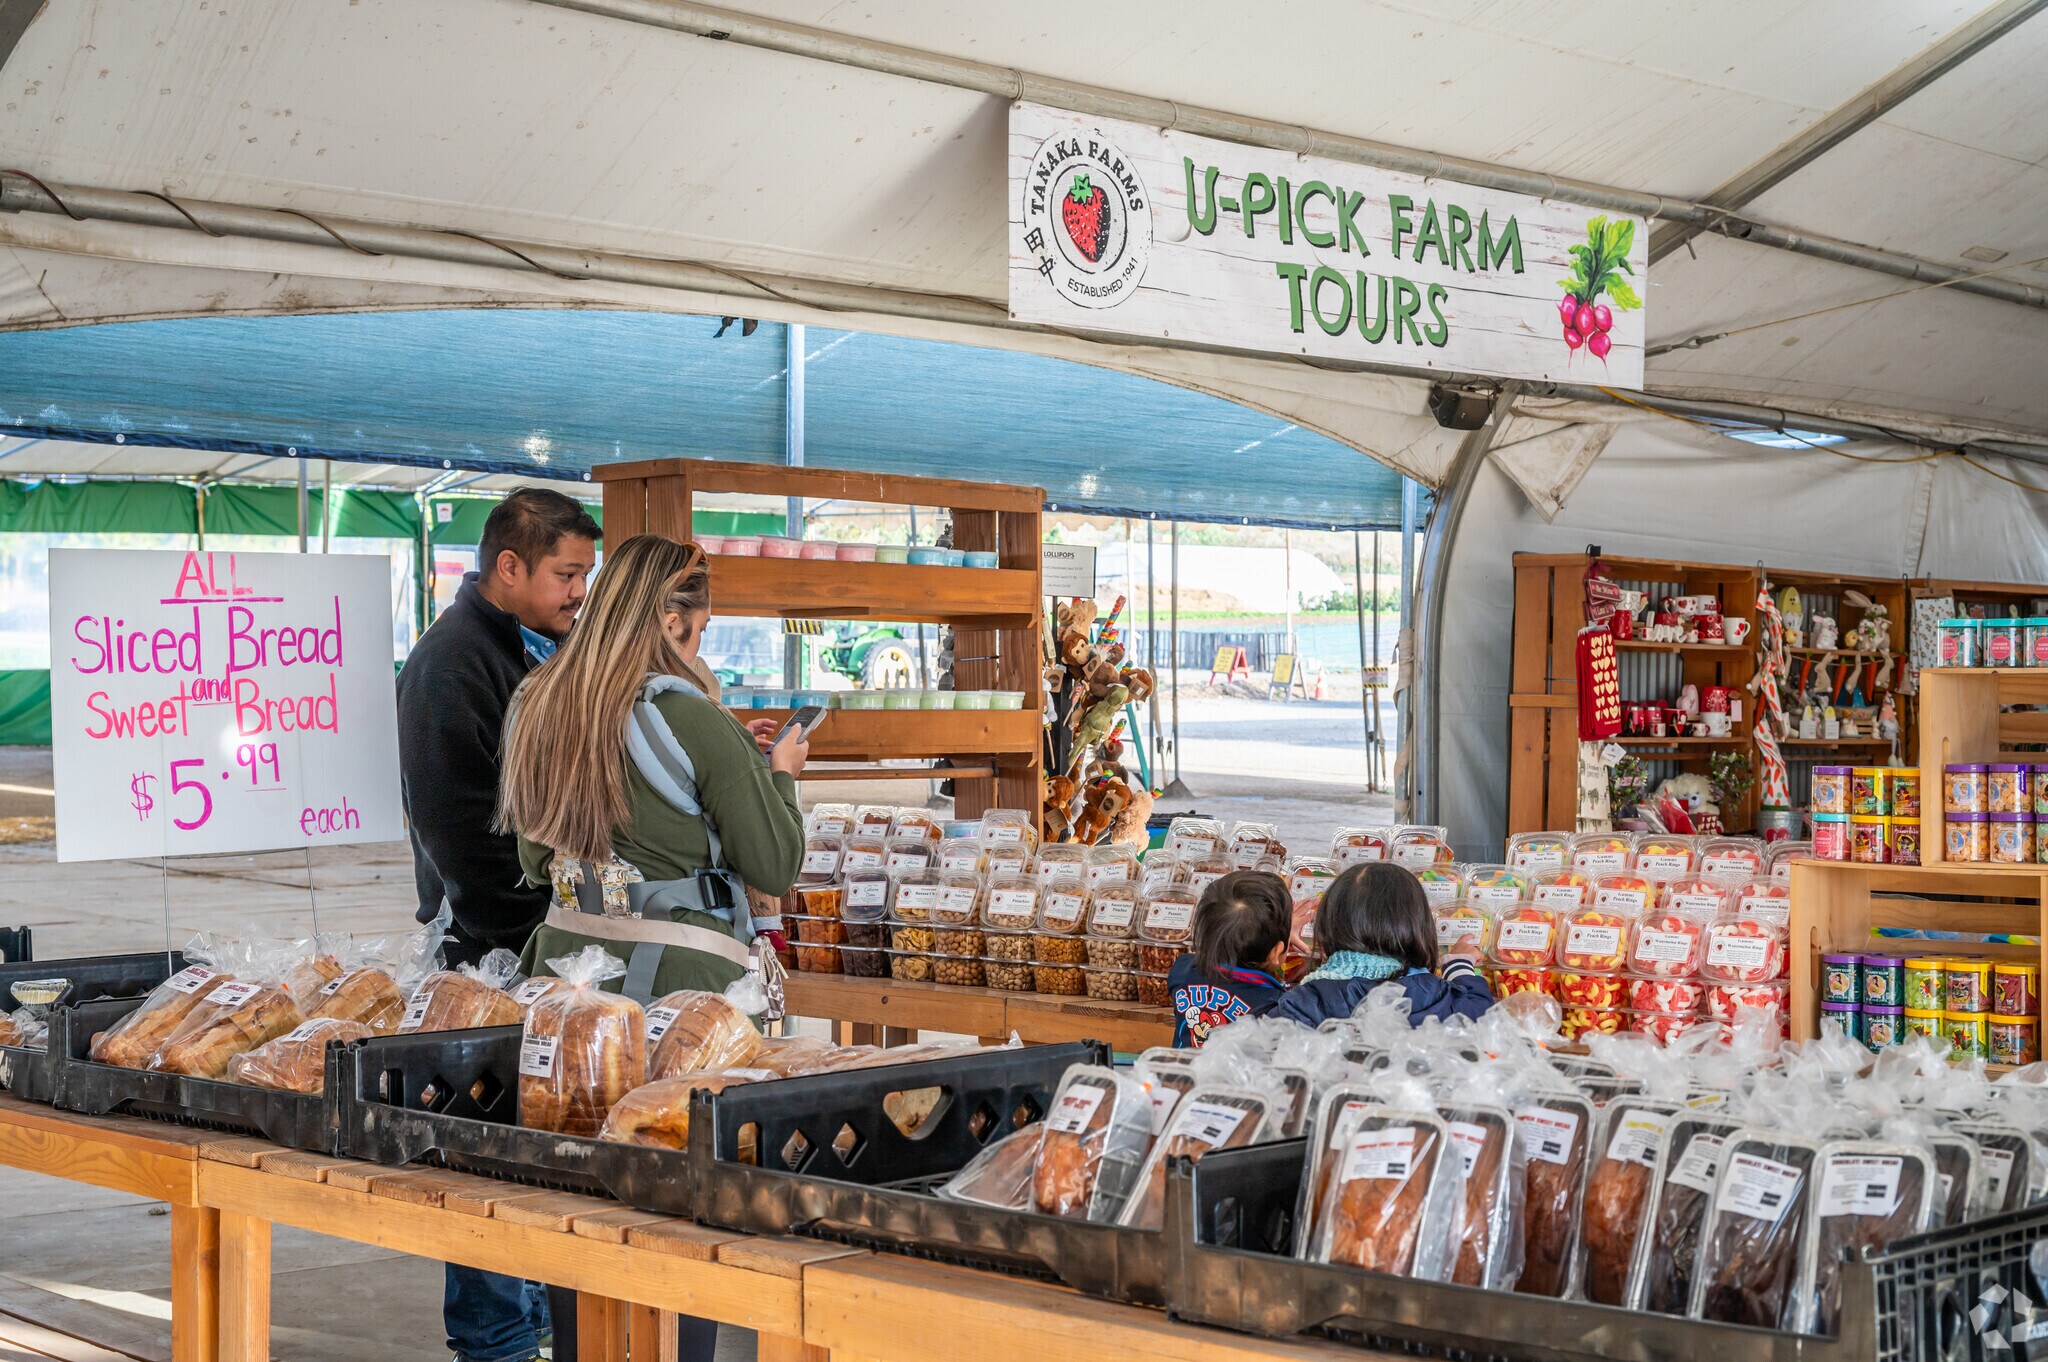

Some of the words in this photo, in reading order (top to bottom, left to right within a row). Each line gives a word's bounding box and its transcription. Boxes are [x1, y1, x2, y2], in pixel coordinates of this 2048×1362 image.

[1031, 138, 1083, 216] TANAKA
[1088, 140, 1144, 212] FARMS
[1184, 156, 1371, 258] U-PICK
[1388, 194, 1524, 273] FARM
[1067, 278, 1123, 298] ESTABLISHED
[1122, 257, 1139, 281] 1941
[1276, 262, 1448, 347] TOURS
[174, 551, 253, 598] ALL
[71, 606, 202, 675] Sliced
[228, 595, 343, 673] Bread
[191, 663, 232, 703] and
[85, 680, 193, 739] Sweet
[234, 673, 339, 737] Bread
[299, 796, 360, 836] each
[1176, 984, 1251, 1022] SUPE
[1536, 1118, 1553, 1126] SWEET
[1554, 1121, 1571, 1130] BREAD
[1736, 1158, 1762, 1168] CHOCOLATE
[1763, 1164, 1781, 1172] SWEET
[1782, 1170, 1797, 1178] BREAD
